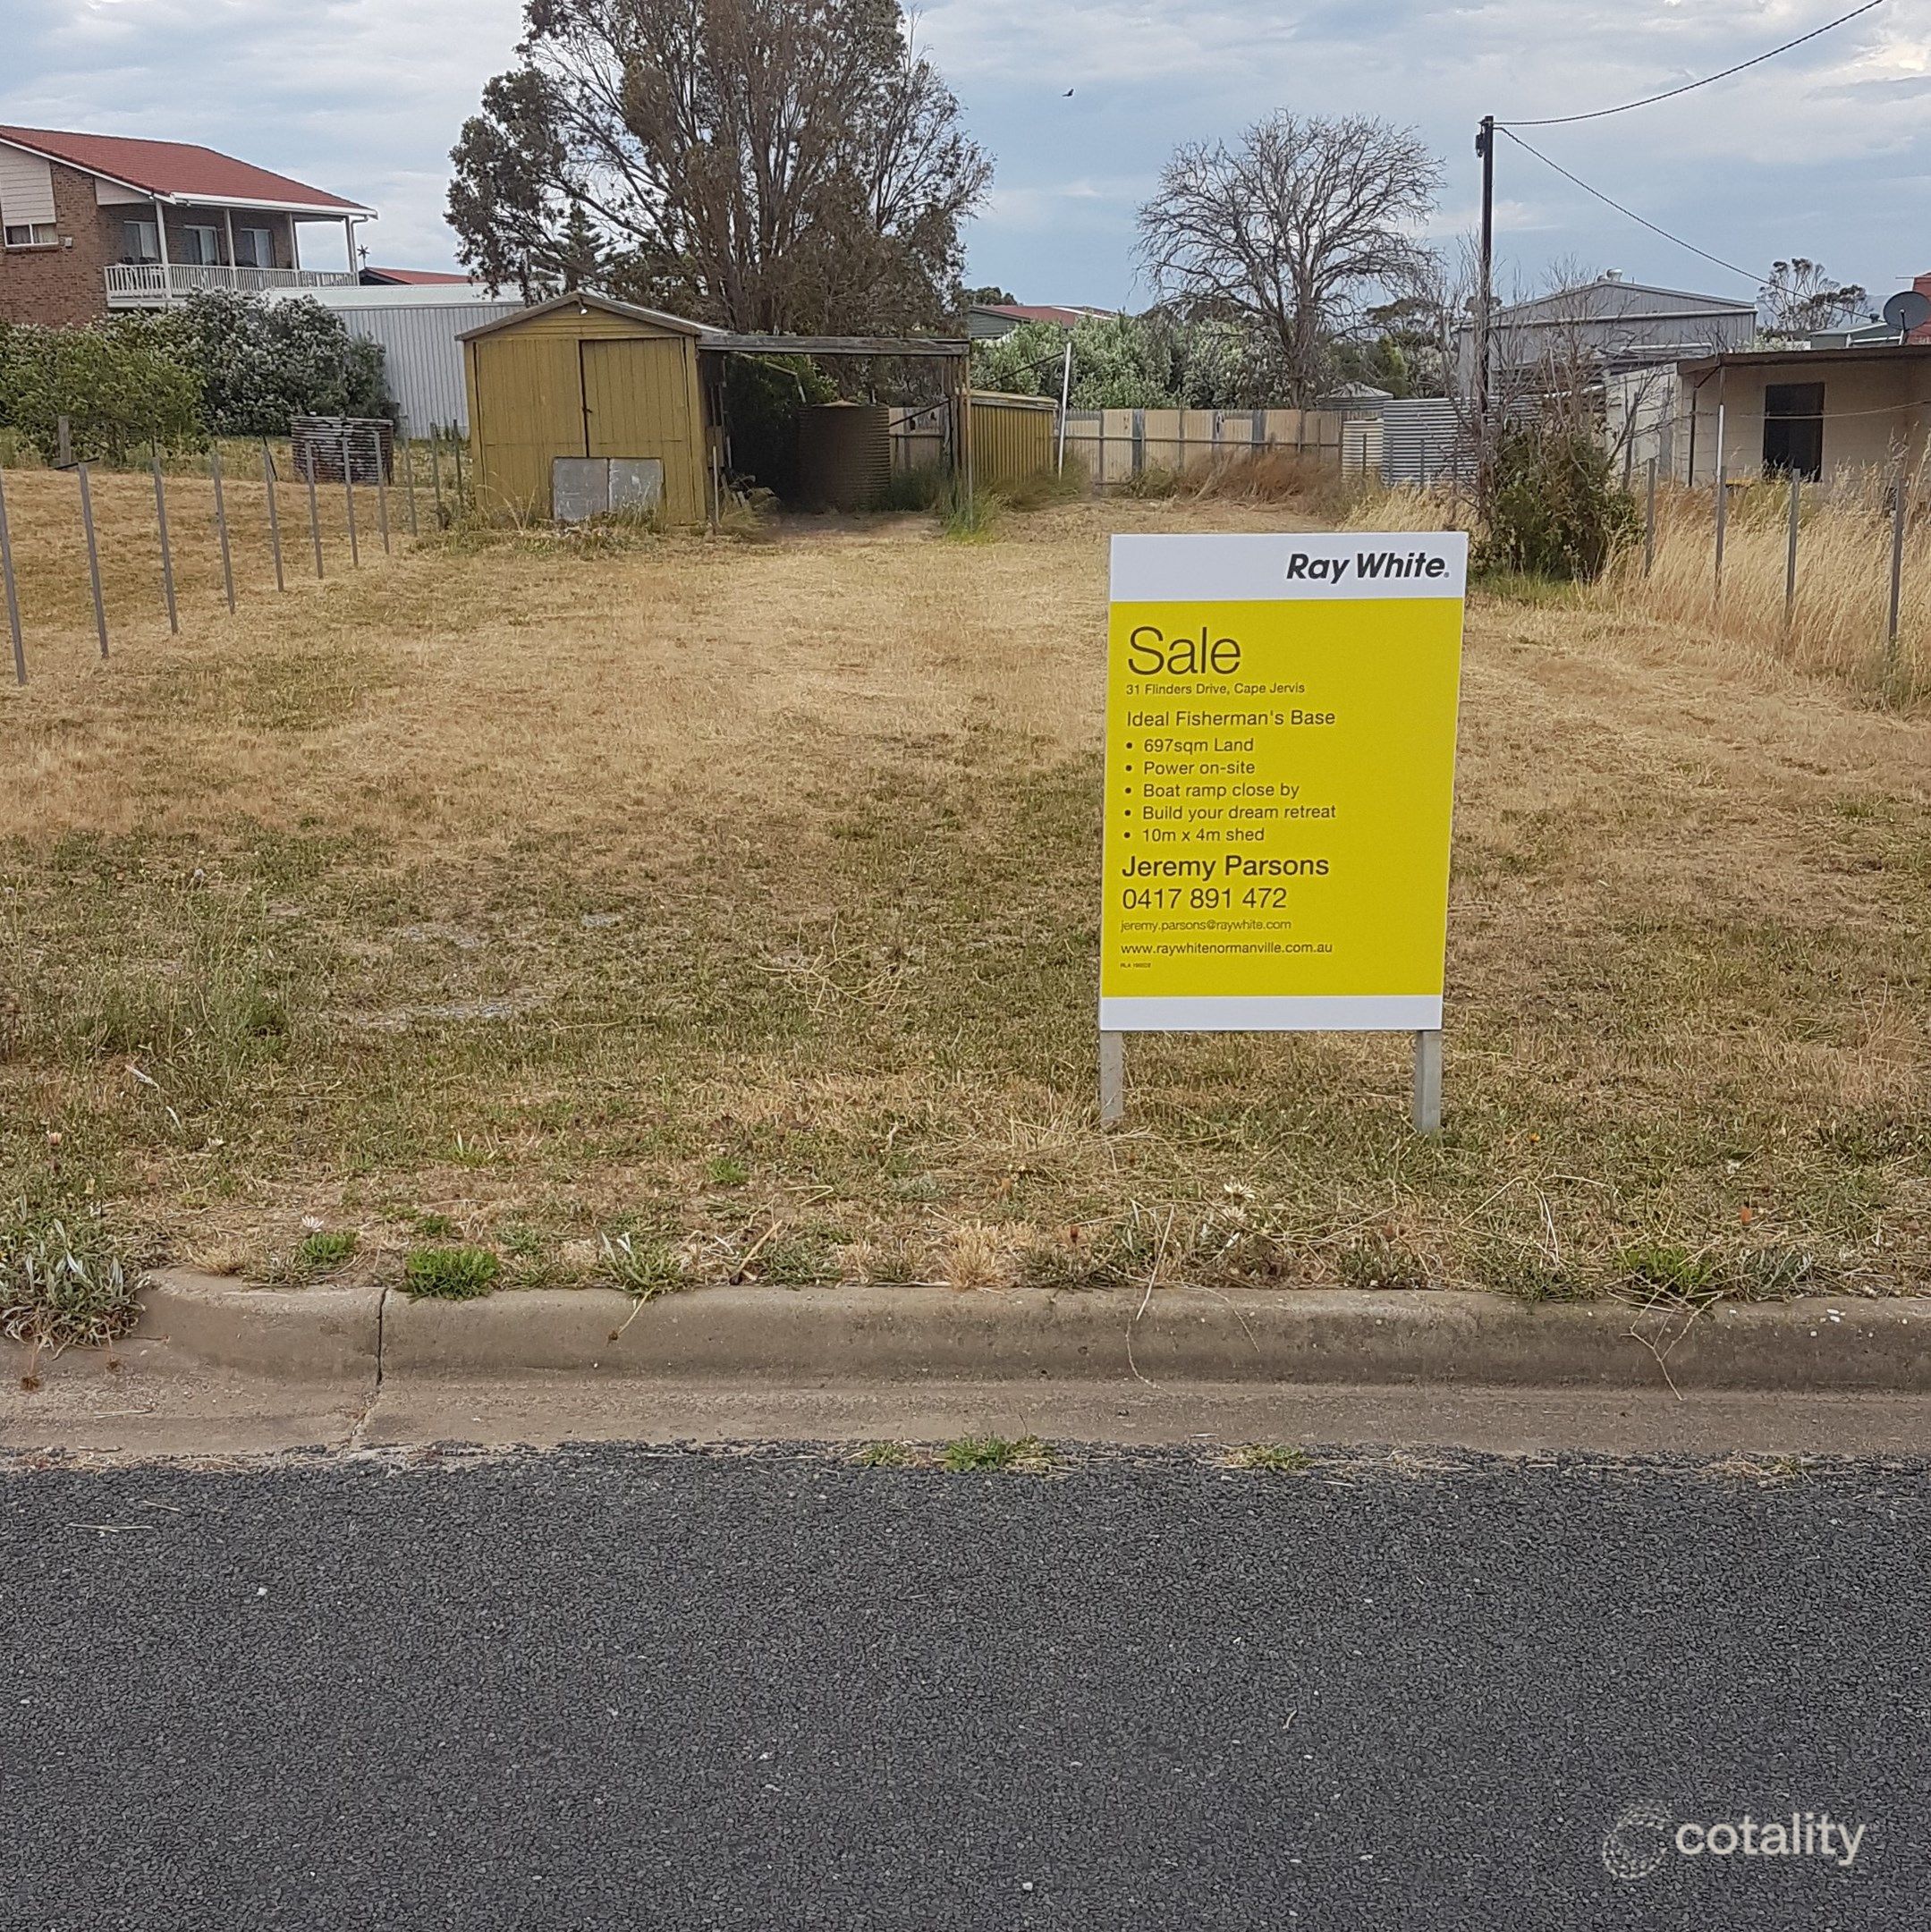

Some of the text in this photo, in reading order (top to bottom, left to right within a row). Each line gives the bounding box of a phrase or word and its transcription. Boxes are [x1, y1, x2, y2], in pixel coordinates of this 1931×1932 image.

[1287, 554, 1350, 584] Ray
[1129, 626, 1241, 675] Sale
[1126, 684, 1139, 695] 31
[1145, 684, 1191, 694] Flinders
[1234, 682, 1266, 695] Cape
[1270, 682, 1305, 693] Jervis
[1128, 710, 1334, 726] Ideal Fisherman's Base
[1145, 738, 1253, 755] 697sqm Land
[1145, 761, 1255, 775] Power on-site
[1144, 783, 1299, 800] Boat ramp close by
[1143, 805, 1335, 822] Build your dream retreat
[1143, 827, 1264, 842] 10m x 4m shed
[1122, 855, 1329, 881] Jeremy Parsons
[1123, 887, 1286, 909] 0417 891 472
[1121, 919, 1292, 933] jeremy.parsons@raywhite.com
[1121, 942, 1332, 956] www.raywhitenormanville.com.au
